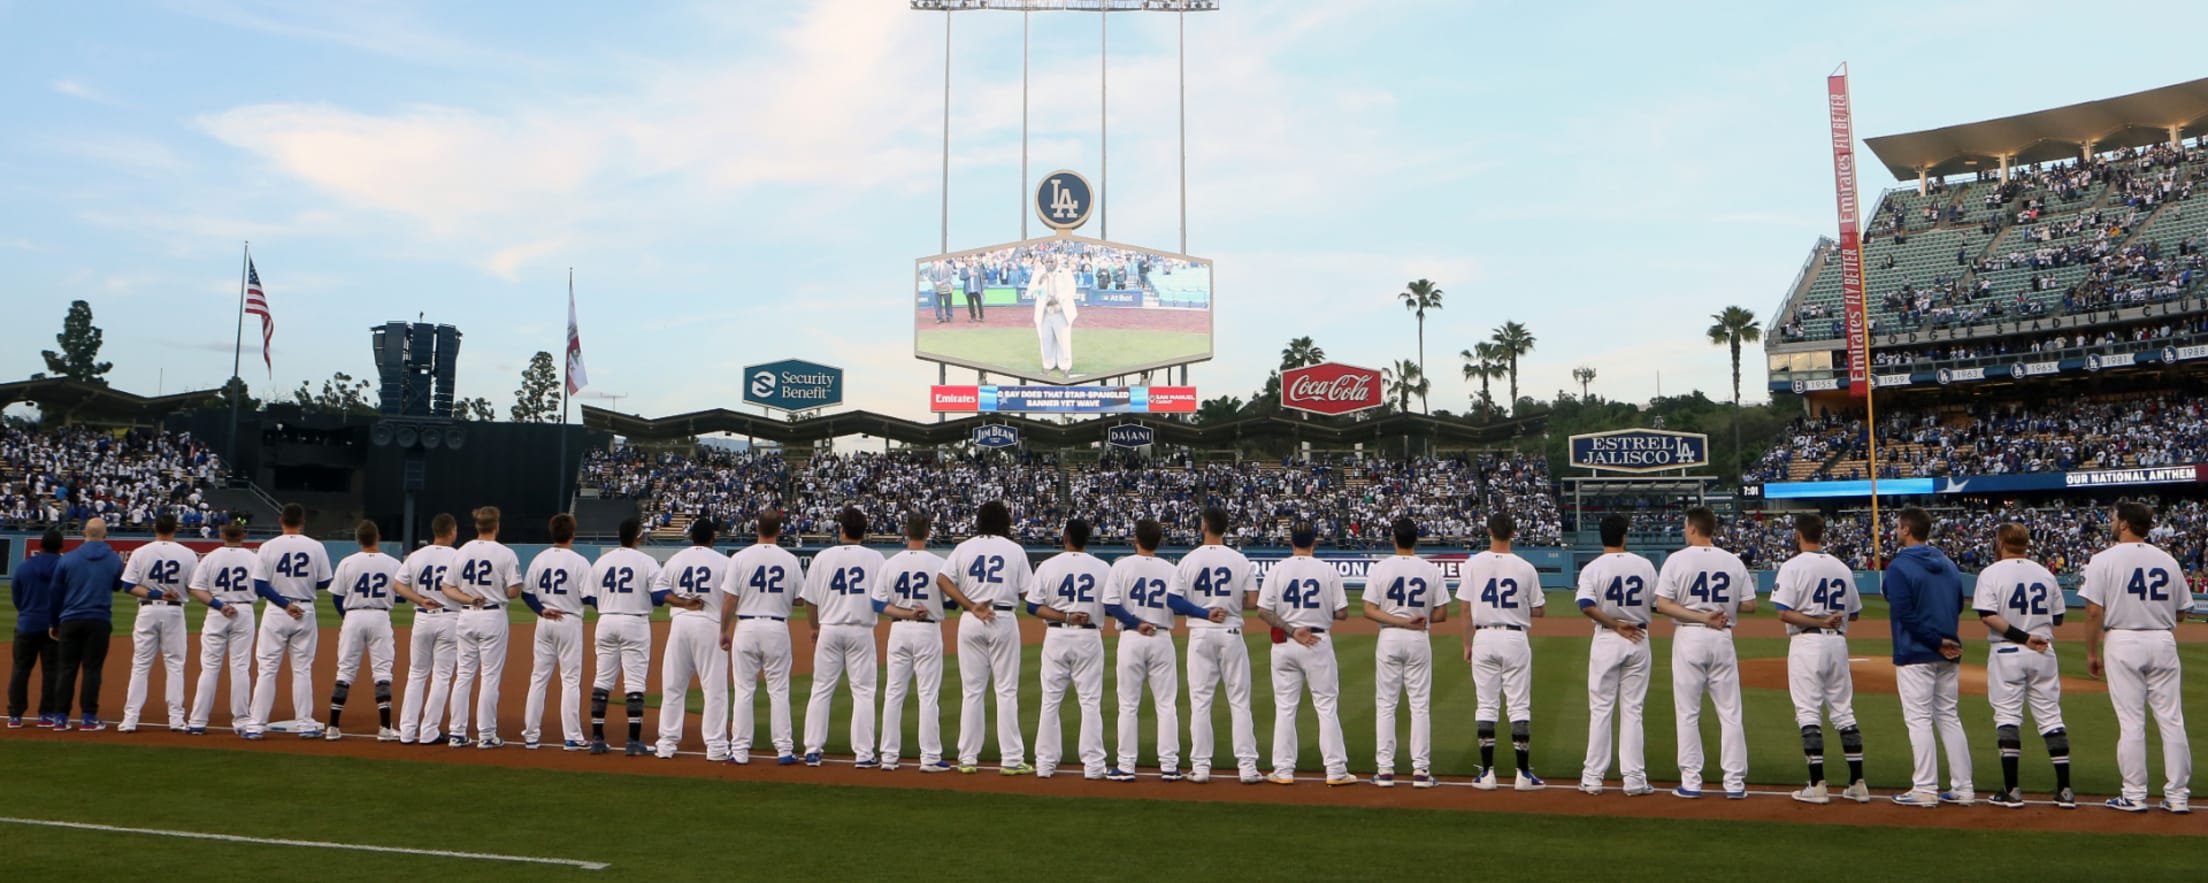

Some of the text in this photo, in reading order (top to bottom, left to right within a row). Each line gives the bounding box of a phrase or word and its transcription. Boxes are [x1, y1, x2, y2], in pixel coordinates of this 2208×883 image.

[1831, 94, 1856, 224] Emirates FLY BETTER
[1050, 179, 1079, 218] LA
[1842, 249, 1866, 382] Emirates FLY BETTER
[1869, 298, 2207, 345] DODGER STADIUM CLUB
[782, 371, 835, 388] Security
[782, 386, 827, 399] Benefit
[1290, 375, 1373, 402] Coca-Cola
[935, 394, 976, 403] Emirates
[975, 426, 1014, 443] JIM BEAM
[1111, 430, 1150, 442] DASANI
[1583, 450, 1670, 464] JALISCO
[2066, 468, 2197, 485] OUR NATIONAL ANTHEM
[1743, 486, 1759, 496] 7:01
[148, 560, 180, 585] 42
[276, 553, 309, 577] 42
[418, 565, 447, 591] 42
[462, 560, 492, 585] 42
[969, 556, 1004, 583] 42
[215, 567, 247, 592] 42
[354, 573, 388, 598] 42
[539, 568, 567, 595] 42
[603, 567, 633, 593] 42
[679, 567, 710, 593] 42
[750, 566, 784, 593] 42
[830, 567, 864, 595] 42
[894, 572, 929, 600] 42
[1058, 574, 1094, 602] 42
[1194, 567, 1231, 596] 42
[1387, 577, 1426, 607] 42
[1481, 578, 1518, 608] 42
[1605, 576, 1643, 606] 42
[1690, 572, 1730, 603] 42
[2127, 568, 2169, 601] 42
[1130, 578, 1166, 609] 42
[1283, 579, 1319, 608] 42
[1813, 578, 1846, 610] 42
[2009, 583, 2048, 613] 42
